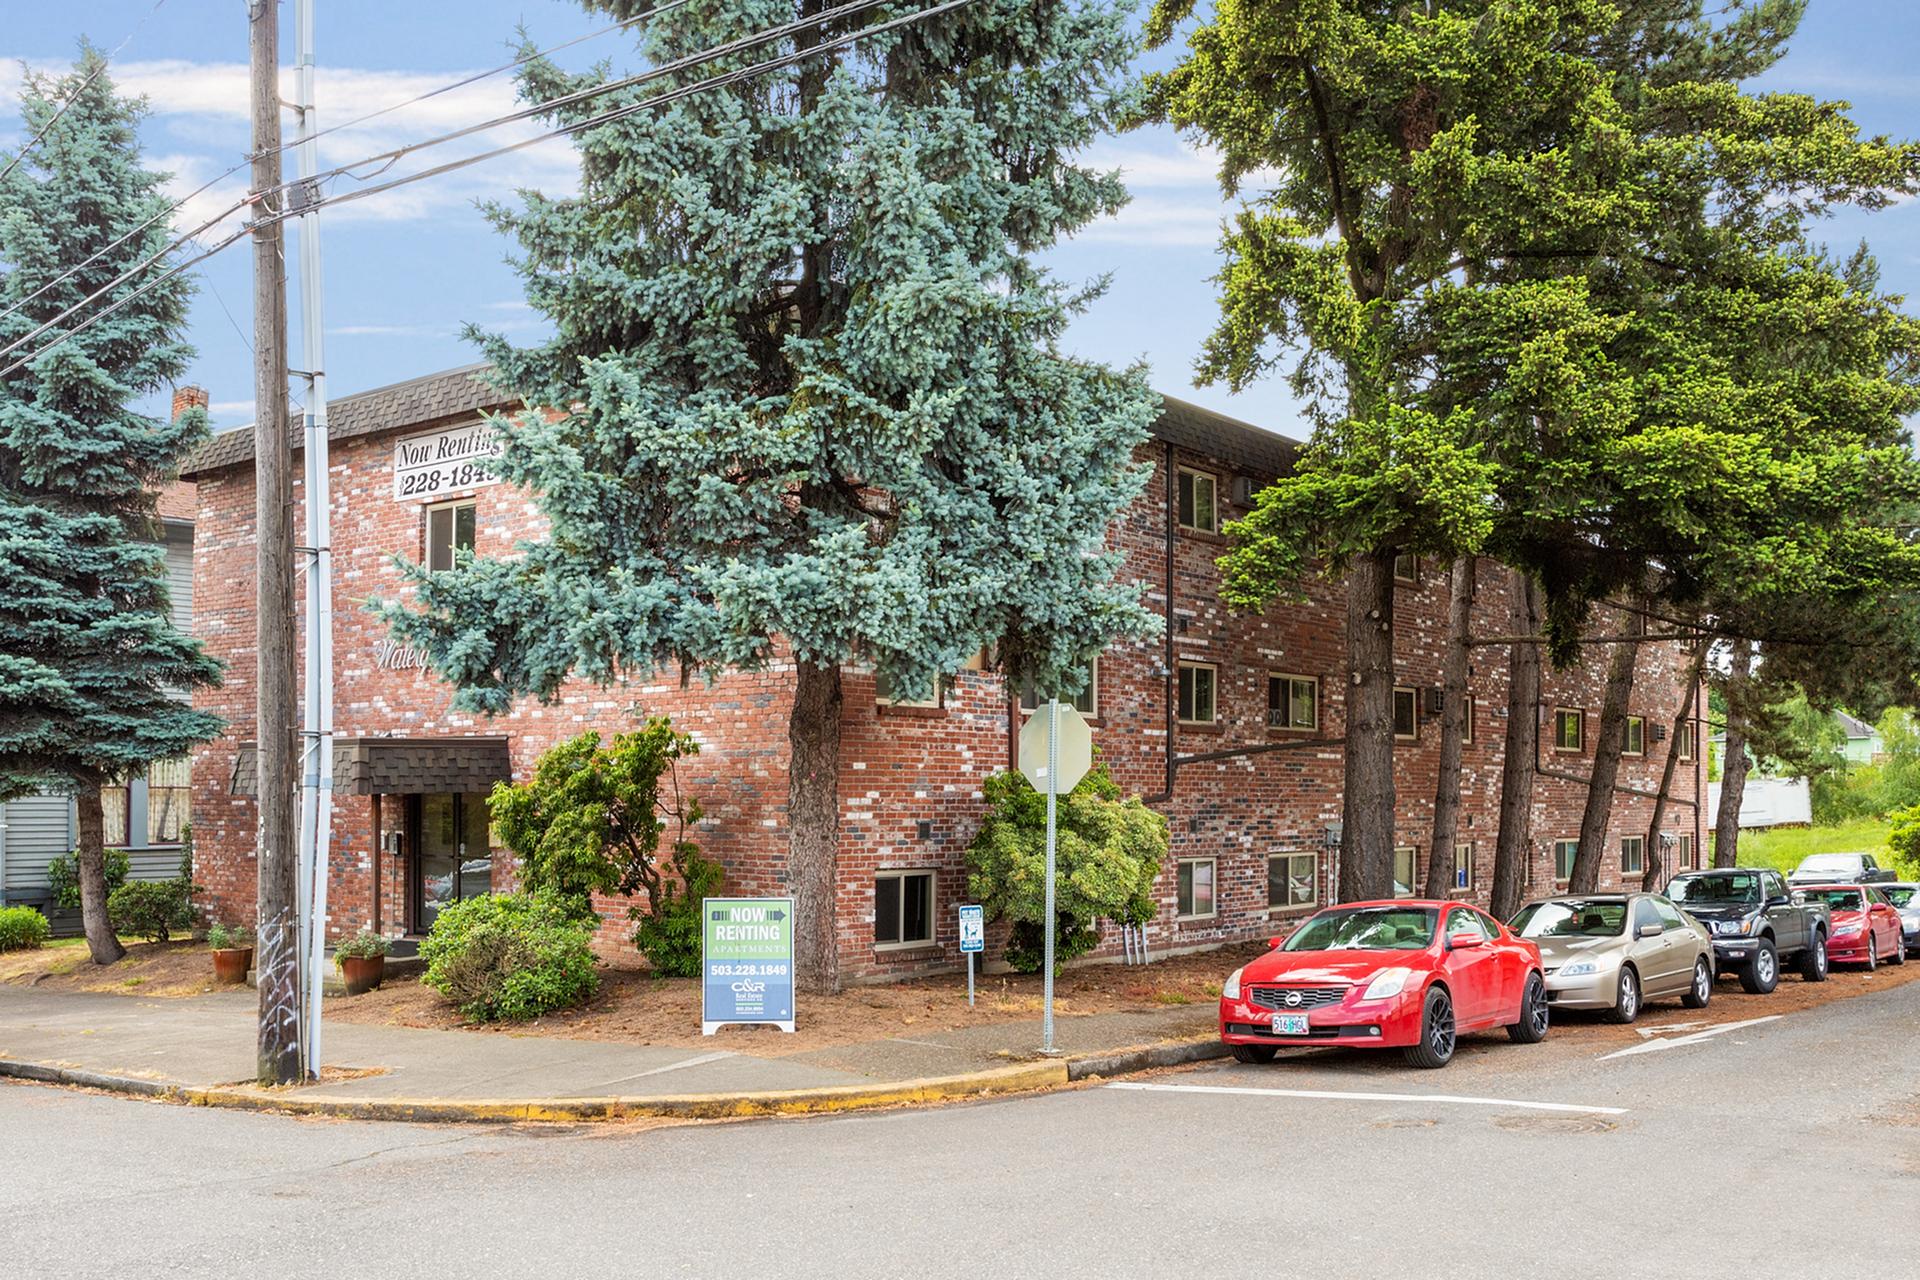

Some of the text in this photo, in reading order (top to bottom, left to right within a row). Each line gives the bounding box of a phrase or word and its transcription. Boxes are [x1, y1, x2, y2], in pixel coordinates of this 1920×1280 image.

[398, 443, 433, 467] Now
[730, 907, 766, 923] NOW
[715, 925, 780, 941] RENTING
[712, 944, 787, 953] APARTMENTS
[711, 965, 787, 976] 503.228.1849
[731, 978, 765, 991] C&R
